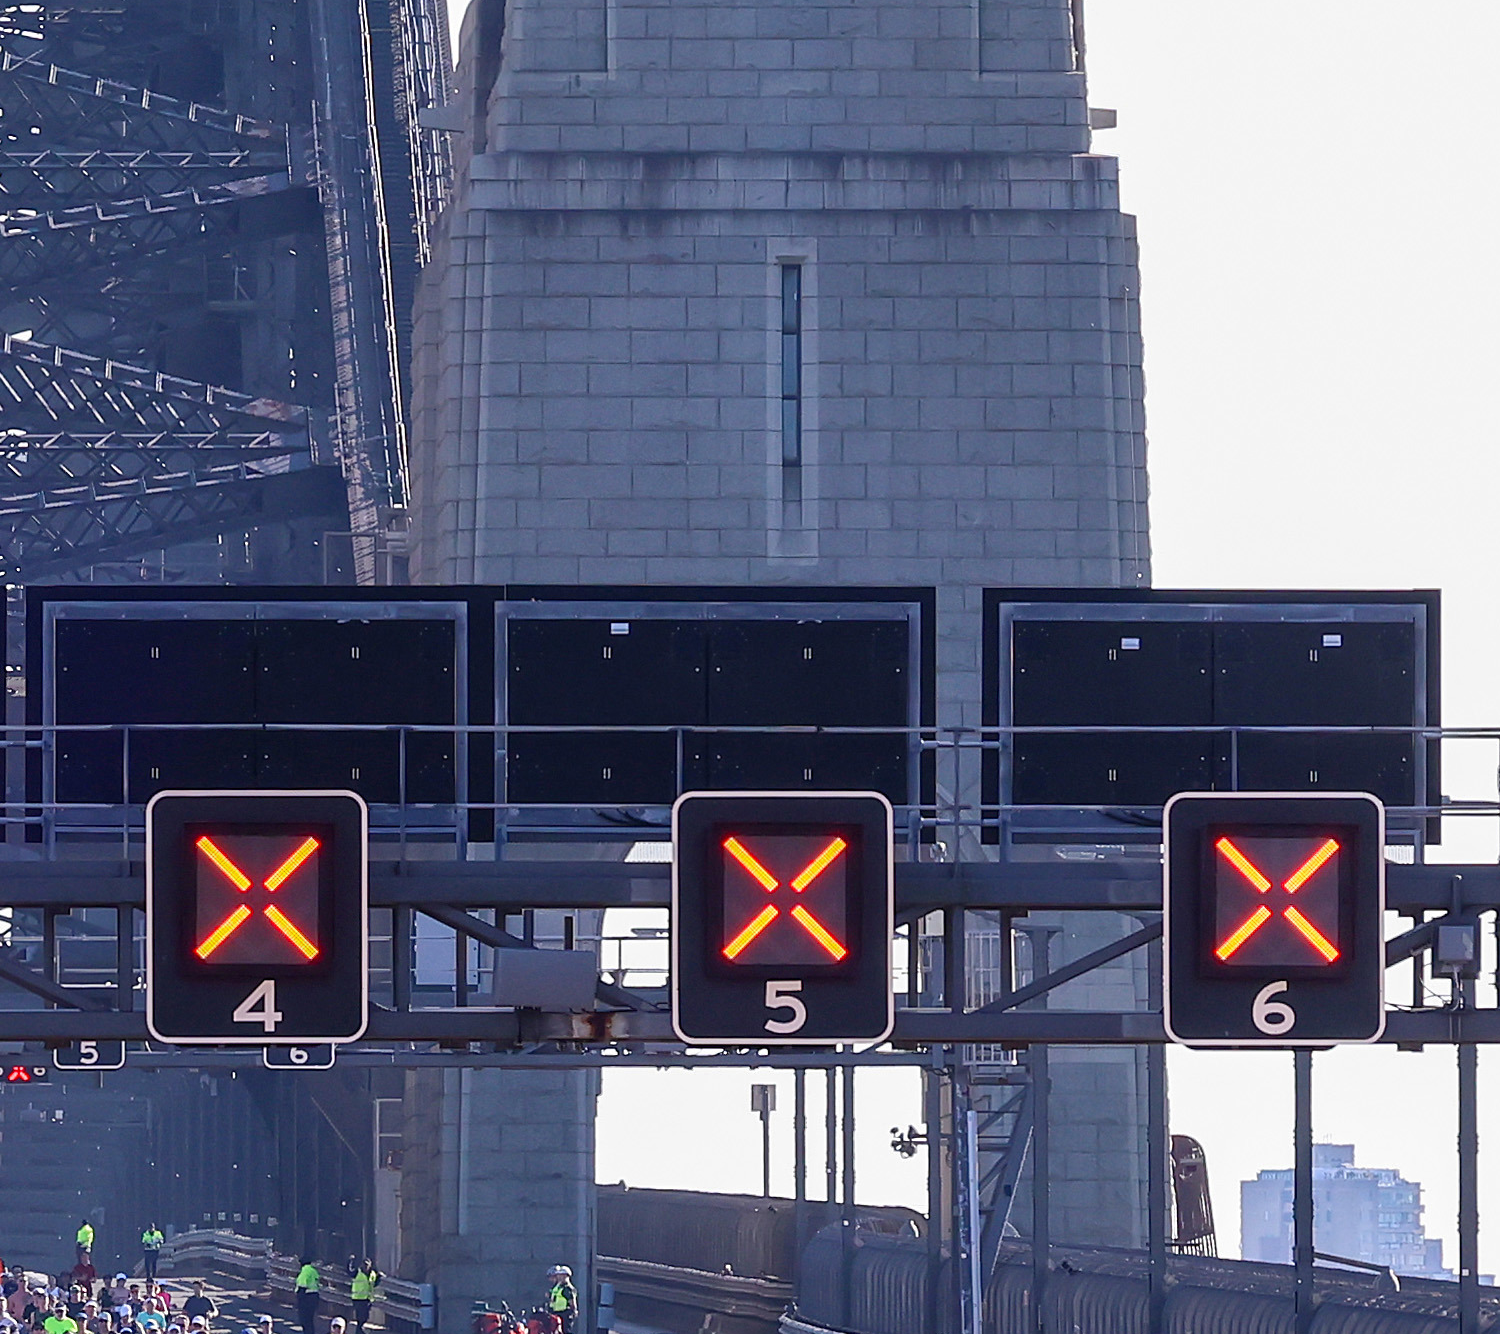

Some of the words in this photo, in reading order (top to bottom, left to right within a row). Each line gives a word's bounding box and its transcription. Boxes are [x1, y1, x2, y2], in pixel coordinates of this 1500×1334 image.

[233, 979, 283, 1032] 4
[764, 980, 807, 1034] 5
[1252, 980, 1295, 1035] 6
[79, 1040, 101, 1065] 5
